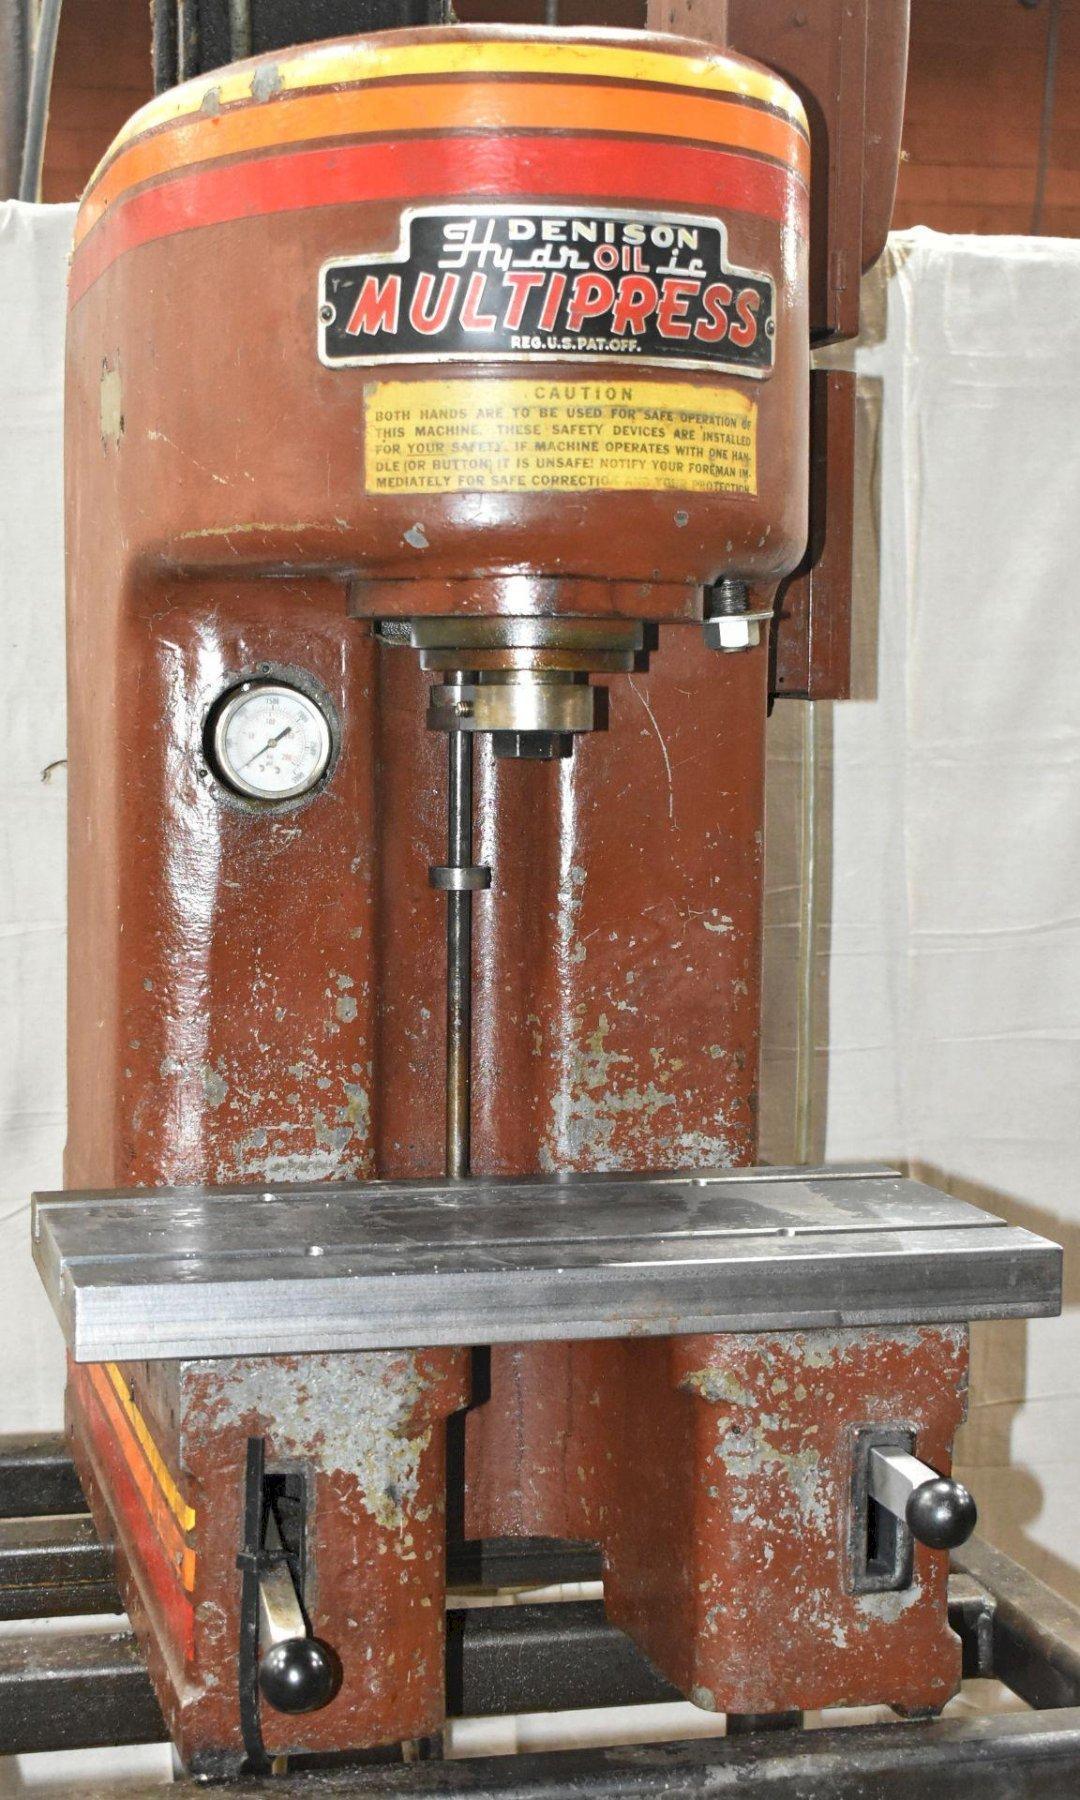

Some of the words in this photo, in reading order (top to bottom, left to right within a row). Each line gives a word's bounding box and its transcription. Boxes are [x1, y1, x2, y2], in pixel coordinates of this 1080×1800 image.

[508, 218, 698, 250] DENISON
[345, 271, 761, 348] MULTIPRESS
[534, 386, 633, 401] CAUTION
[375, 410, 410, 421] BOTH
[419, 408, 467, 420] HANDS
[476, 408, 503, 419] ARE
[512, 407, 530, 418] TO
[539, 407, 558, 418] BE
[566, 408, 602, 418] USED
[611, 408, 636, 419] FOR
[644, 410, 674, 421] SAFE
[680, 412, 737, 427] OPERATION
[376, 427, 405, 438] THIS
[498, 424, 541, 435] THESE
[552, 424, 603, 435] SAFETY
[613, 425, 665, 438] DEVICES
[673, 429, 695, 440] ARE
[702, 431, 751, 446] INSTALLED
[376, 444, 401, 455] FOR
[407, 442, 444, 453] YOUR
[515, 441, 528, 451] IF
[534, 441, 599, 452] MACHINE
[605, 441, 670, 454] OPERATES
[675, 446, 704, 457] WITH
[709, 448, 728, 459] ONE
[376, 461, 400, 472] DLE
[497, 458, 510, 468] IT
[516, 458, 529, 468] IS
[600, 458, 646, 469] NOTIFY
[652, 460, 684, 472] YOUR
[689, 462, 736, 477] FOREMAN
[376, 475, 450, 488] MEDIATELY
[458, 475, 484, 486] FOR
[491, 475, 525, 486] SAFE
[532, 475, 619, 487] CORRECTIO
